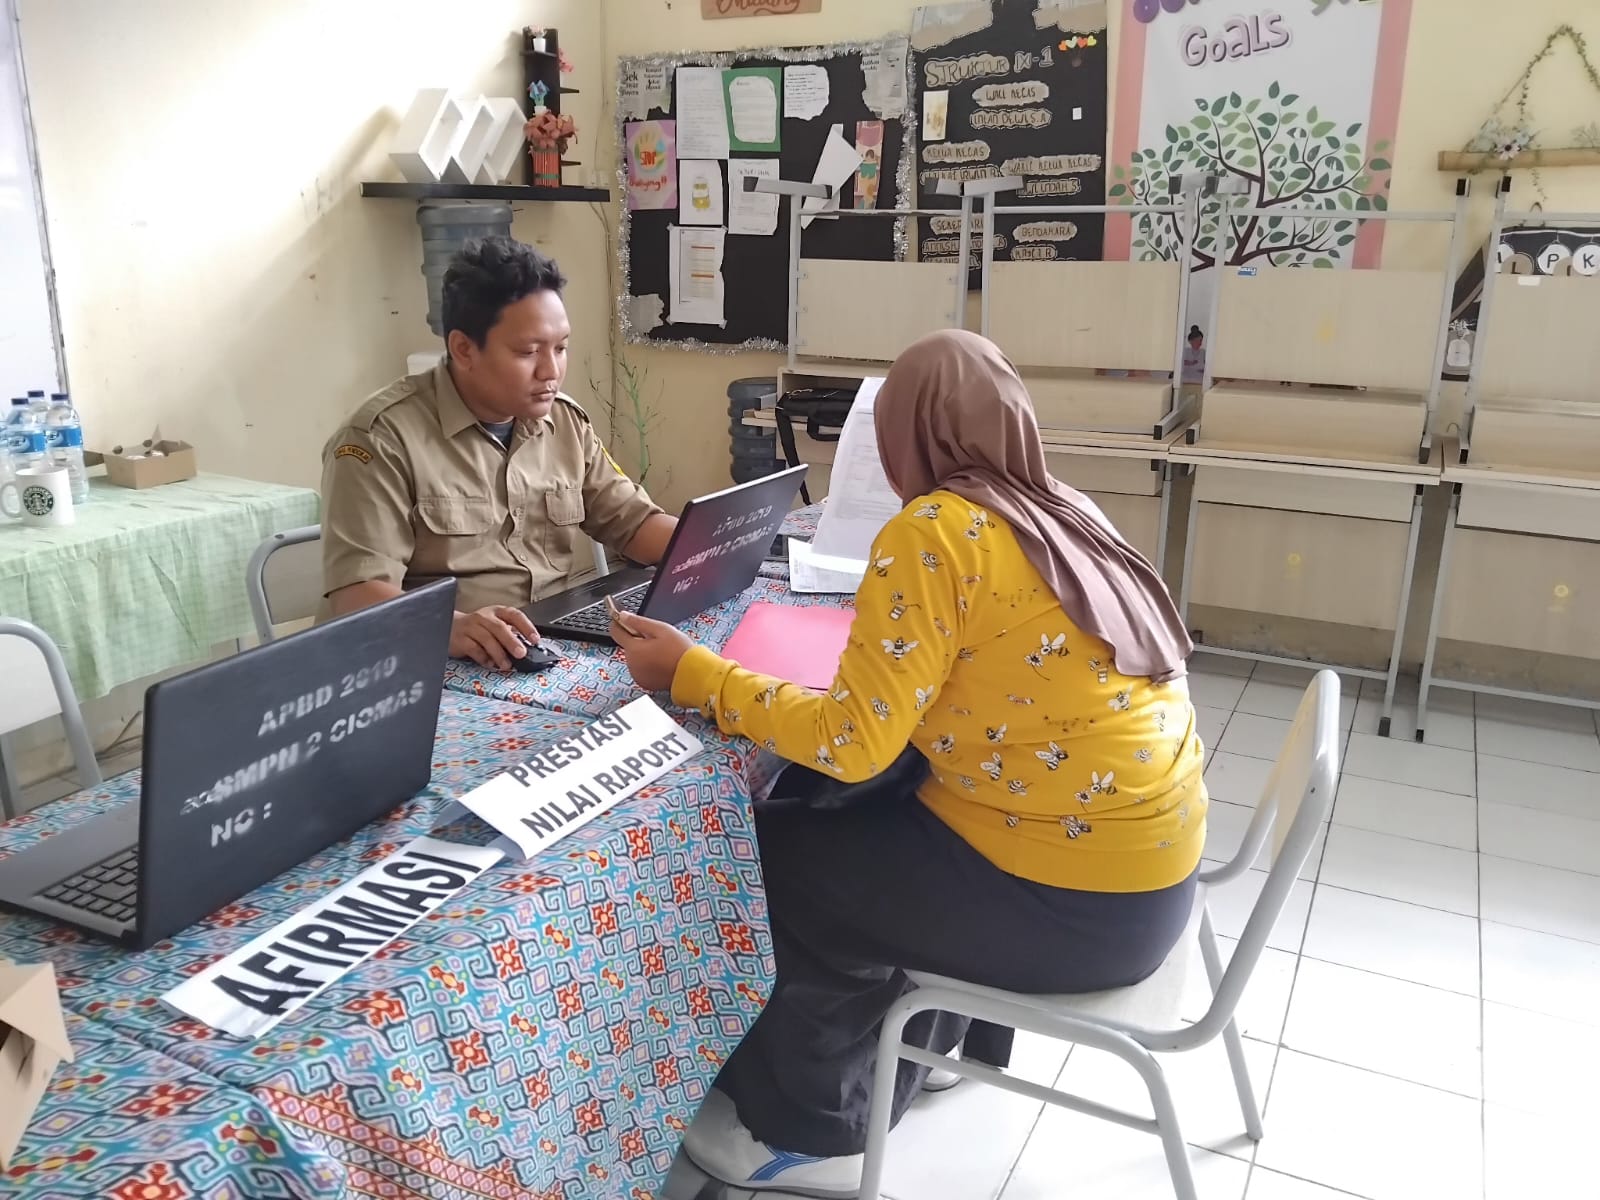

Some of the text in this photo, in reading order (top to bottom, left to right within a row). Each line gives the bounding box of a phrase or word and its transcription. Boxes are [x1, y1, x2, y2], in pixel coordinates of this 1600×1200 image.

[926, 60, 1006, 86] STRUKTUR
[258, 655, 397, 736] APBD 2019
[306, 732, 322, 759] 2
[329, 681, 424, 742] CIOMAS
[506, 712, 633, 788] PRESTASI
[519, 732, 689, 839] NILAI RAPORT
[211, 851, 483, 1016] AFIRMASI
